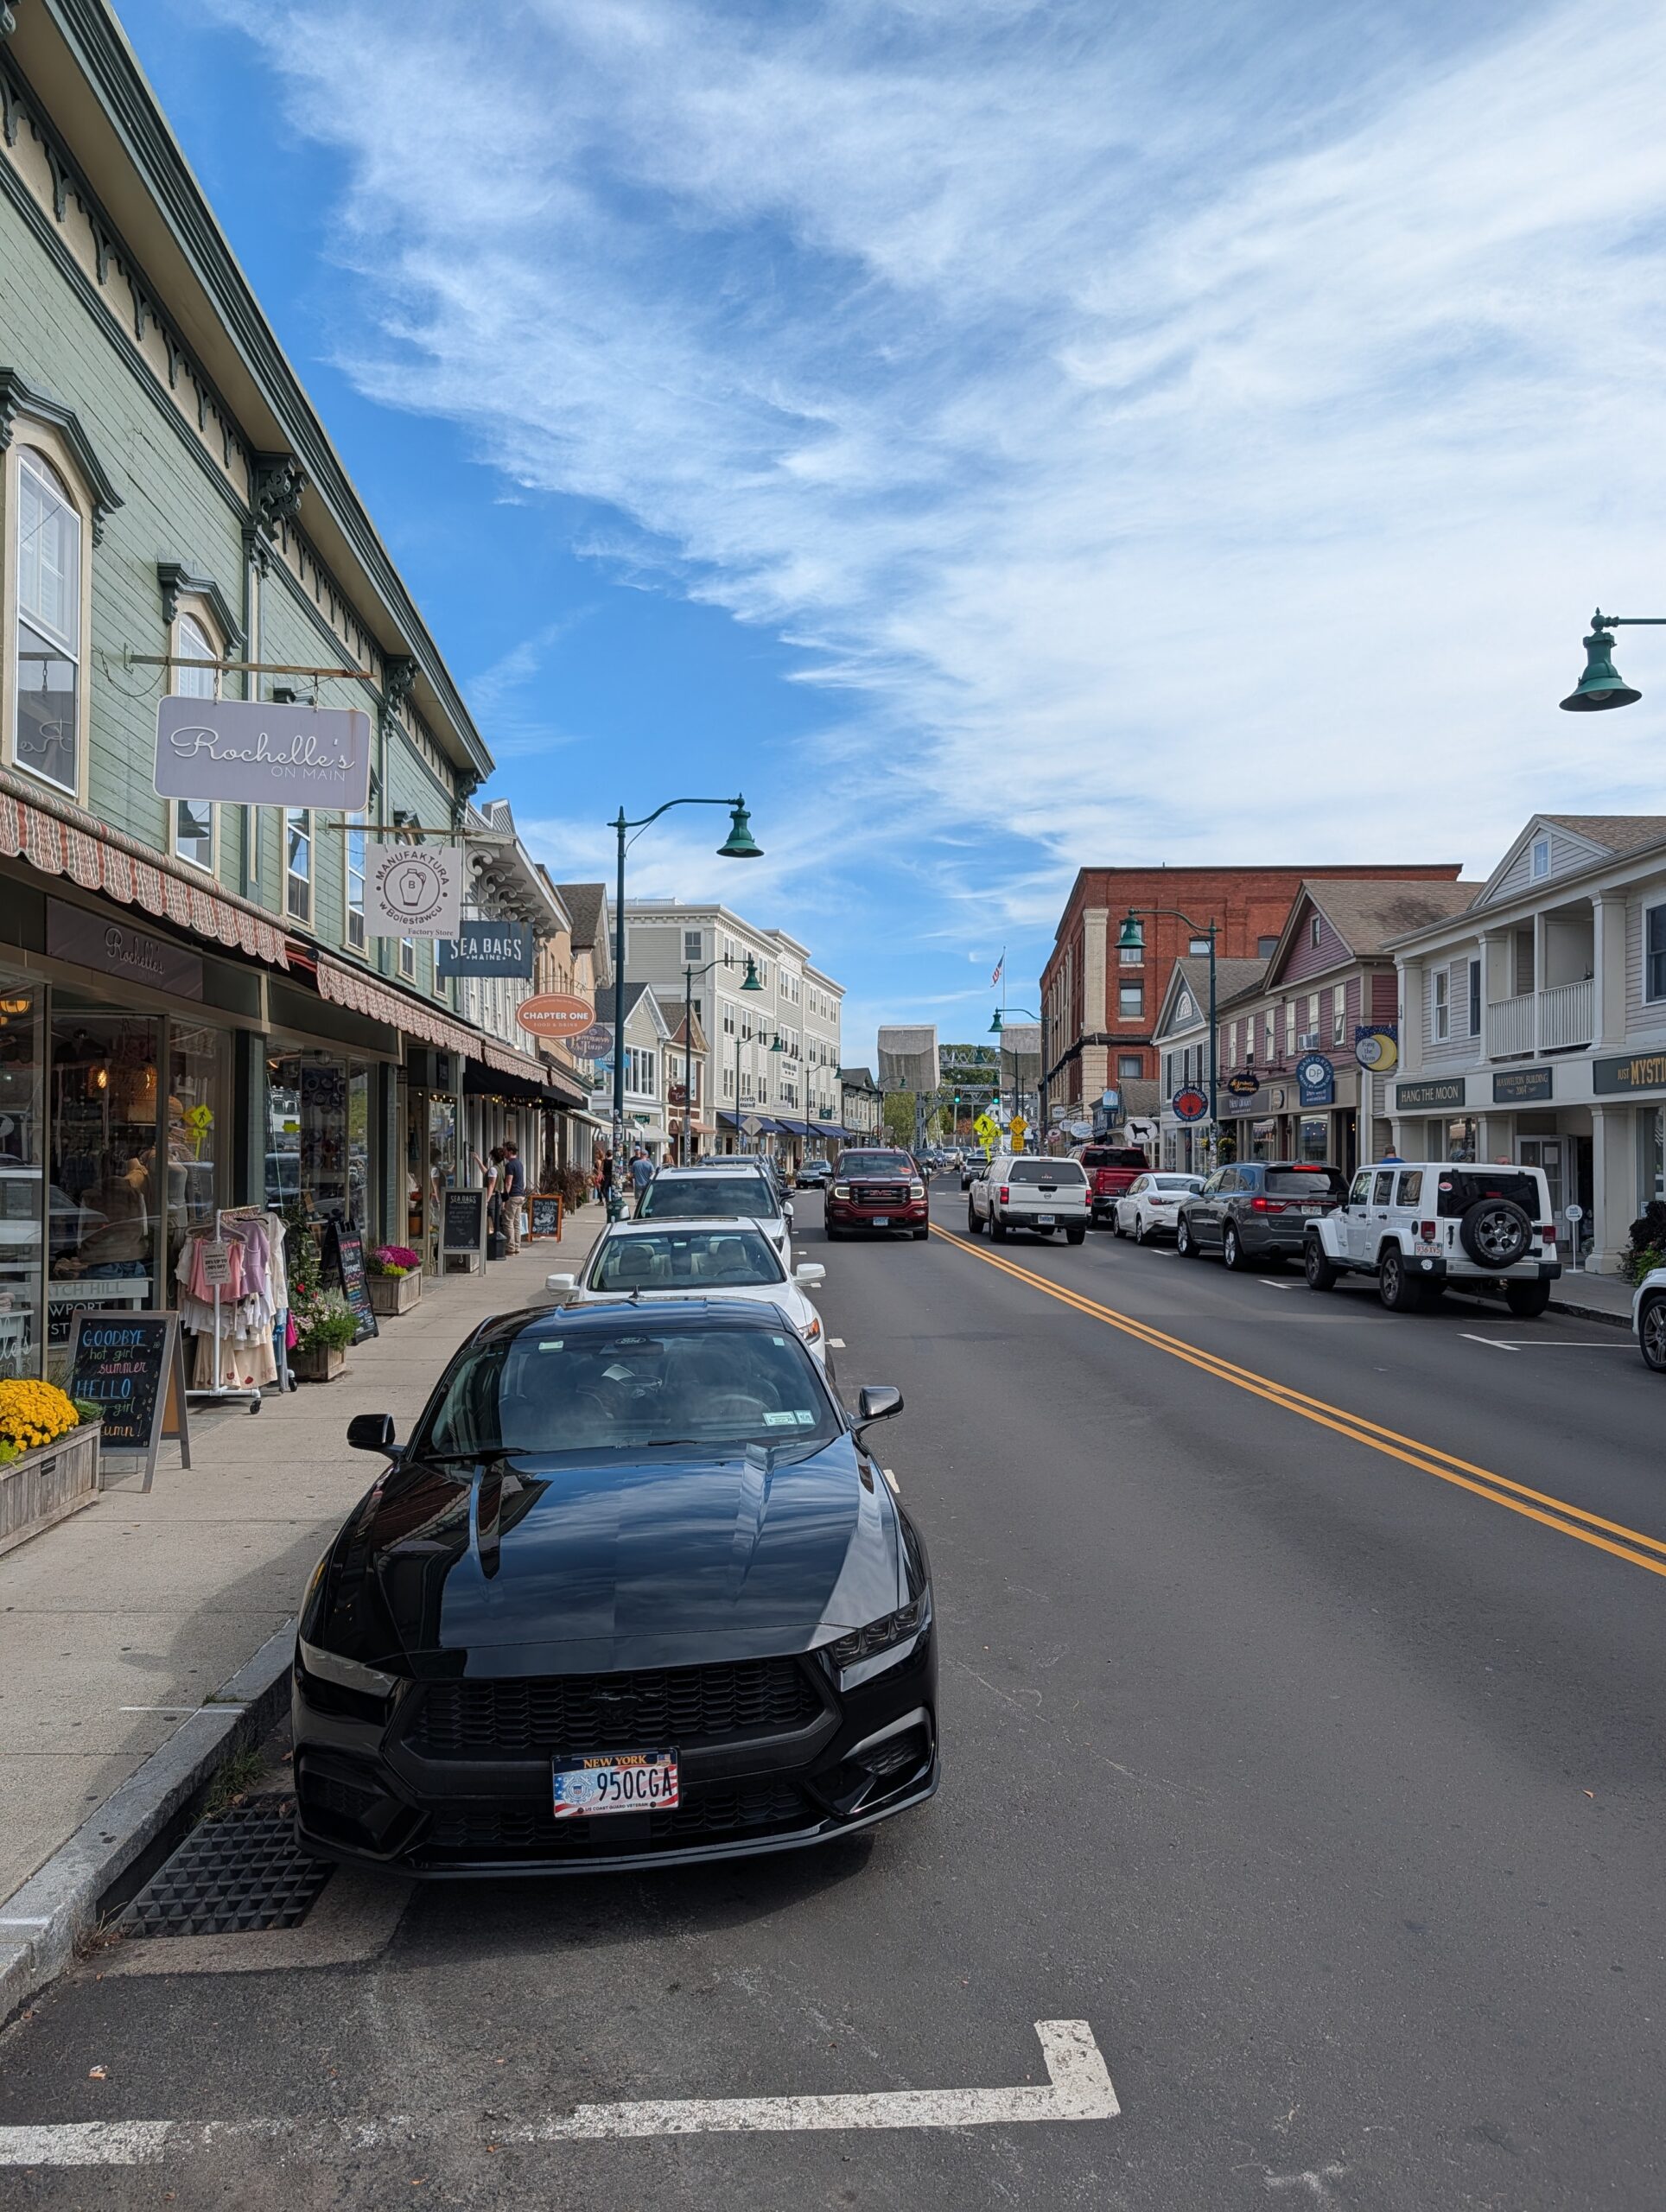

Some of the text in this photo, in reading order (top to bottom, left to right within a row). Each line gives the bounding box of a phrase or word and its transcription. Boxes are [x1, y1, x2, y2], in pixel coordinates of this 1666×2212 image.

[170, 726, 355, 769] Rochelle's
[270, 766, 346, 782] ON MAIN
[375, 850, 449, 885] MANUFAKTURA
[408, 880, 416, 889] B
[408, 927, 434, 937] Factory
[105, 927, 164, 975] Rochelle's
[450, 938, 522, 961] SEA BAGS
[1308, 1068, 1323, 1077] DP
[1525, 1072, 1548, 1084] BUILDING
[1617, 1057, 1666, 1085] JUST MYSTI
[1174, 1089, 1187, 1102] BLEU
[1401, 1085, 1459, 1103] HANG THE MOON
[450, 1195, 461, 1204] SEA
[90, 1280, 125, 1295] HILL
[82, 1330, 147, 1346] GOODBYE
[89, 1345, 135, 1362] hot girl
[97, 1362, 149, 1375] summer
[75, 1378, 132, 1399] HELLO
[112, 1396, 136, 1417] girl
[583, 1754, 647, 1769] NEW YORK
[596, 1767, 672, 1802] 950CGA
